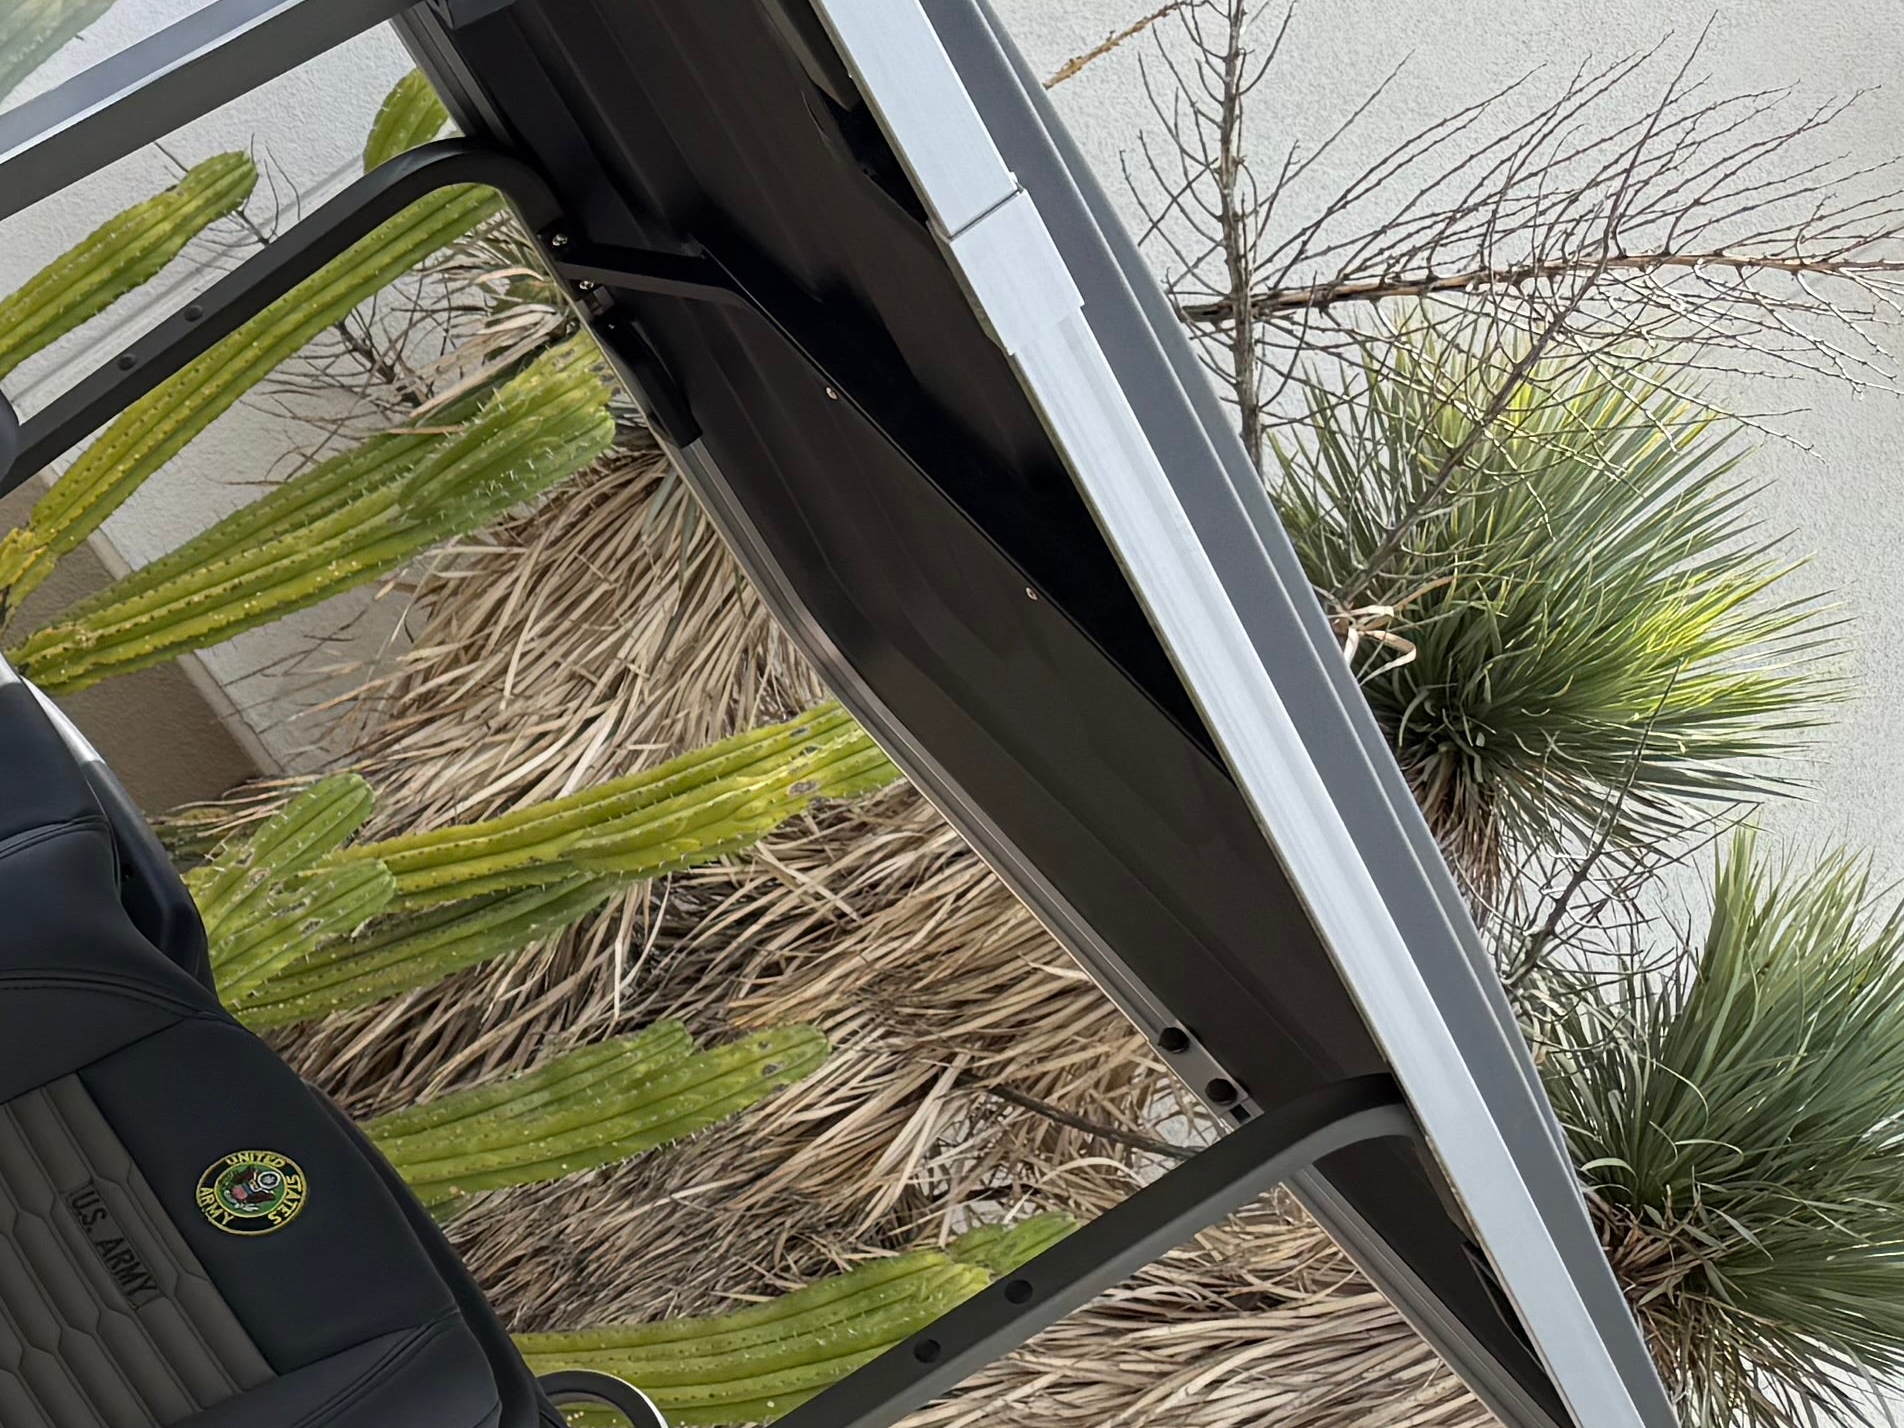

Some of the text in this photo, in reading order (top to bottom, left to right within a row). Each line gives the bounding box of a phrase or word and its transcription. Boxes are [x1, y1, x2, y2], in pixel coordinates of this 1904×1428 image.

[199, 1152, 302, 1225] UNITED STATES ARMY
[68, 1190, 158, 1296] U.S. ARMY
